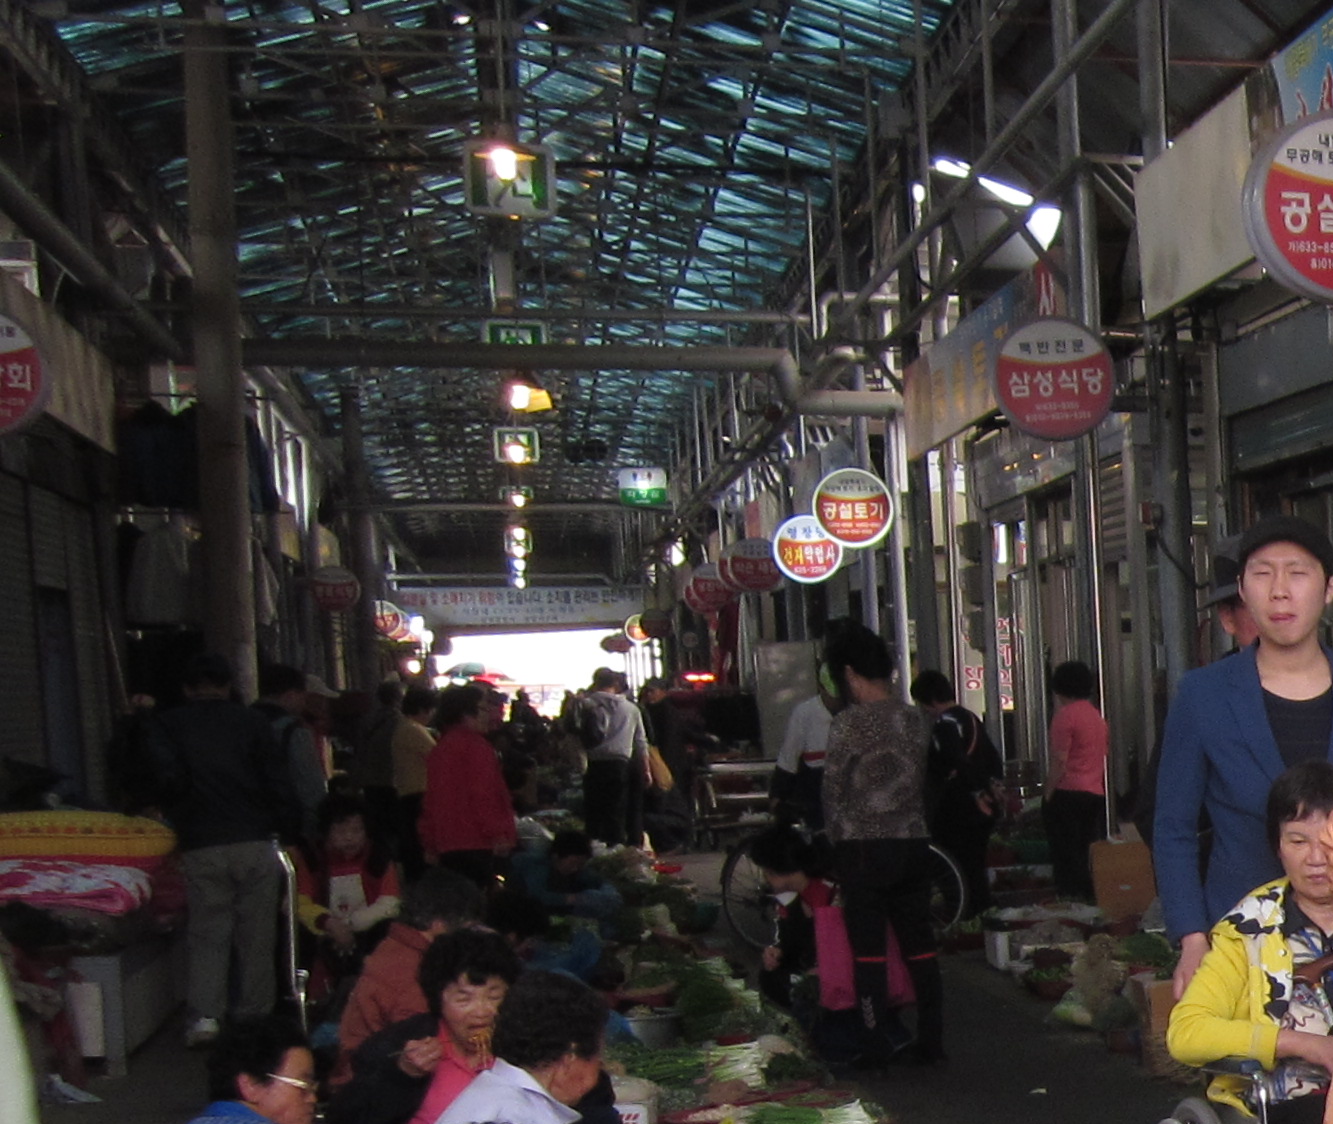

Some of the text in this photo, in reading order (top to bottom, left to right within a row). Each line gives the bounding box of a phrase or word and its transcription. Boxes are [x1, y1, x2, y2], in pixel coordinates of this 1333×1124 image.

[1286, 149, 1323, 164] 무공해
[1008, 367, 1105, 398] 삼성식당
[822, 501, 884, 521] 공설토기
